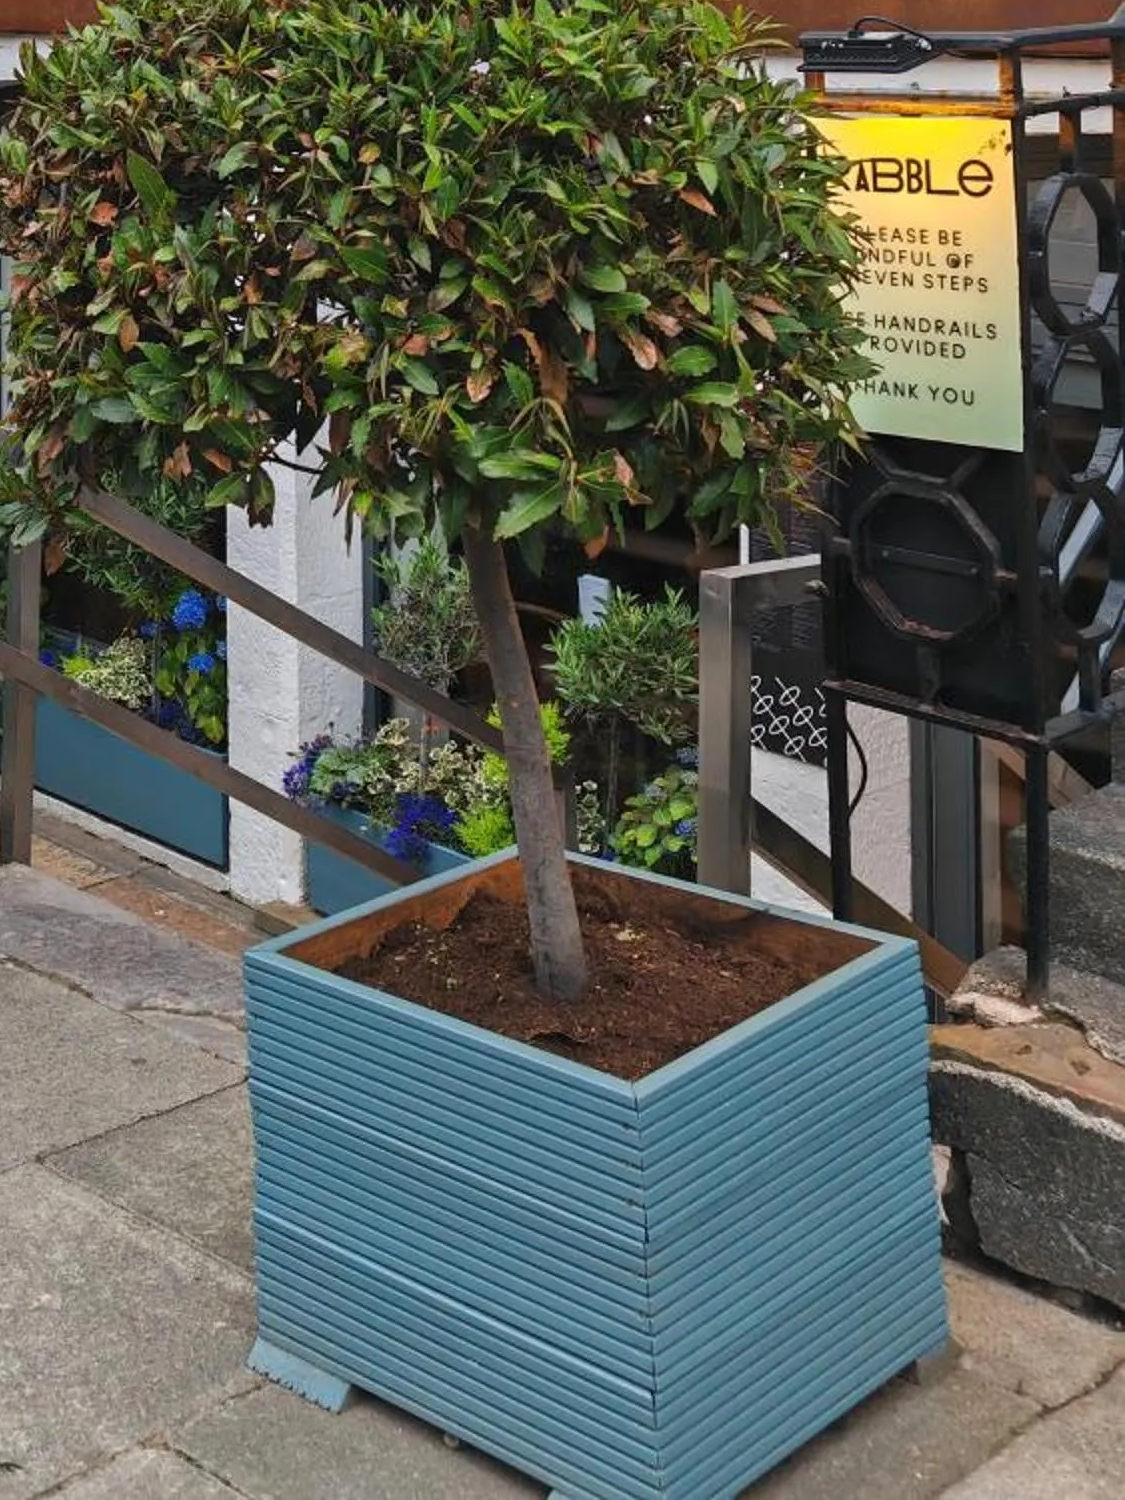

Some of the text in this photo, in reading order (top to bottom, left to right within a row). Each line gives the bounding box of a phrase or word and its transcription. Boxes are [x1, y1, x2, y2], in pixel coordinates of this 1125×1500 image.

[938, 230, 963, 247] BE
[864, 248, 974, 270] NDFUL OF
[860, 269, 989, 294] EVEN STEPS
[843, 311, 998, 341] SE HANDRAILS
[869, 336, 967, 360] ROVIDED
[928, 386, 976, 407] YOU
